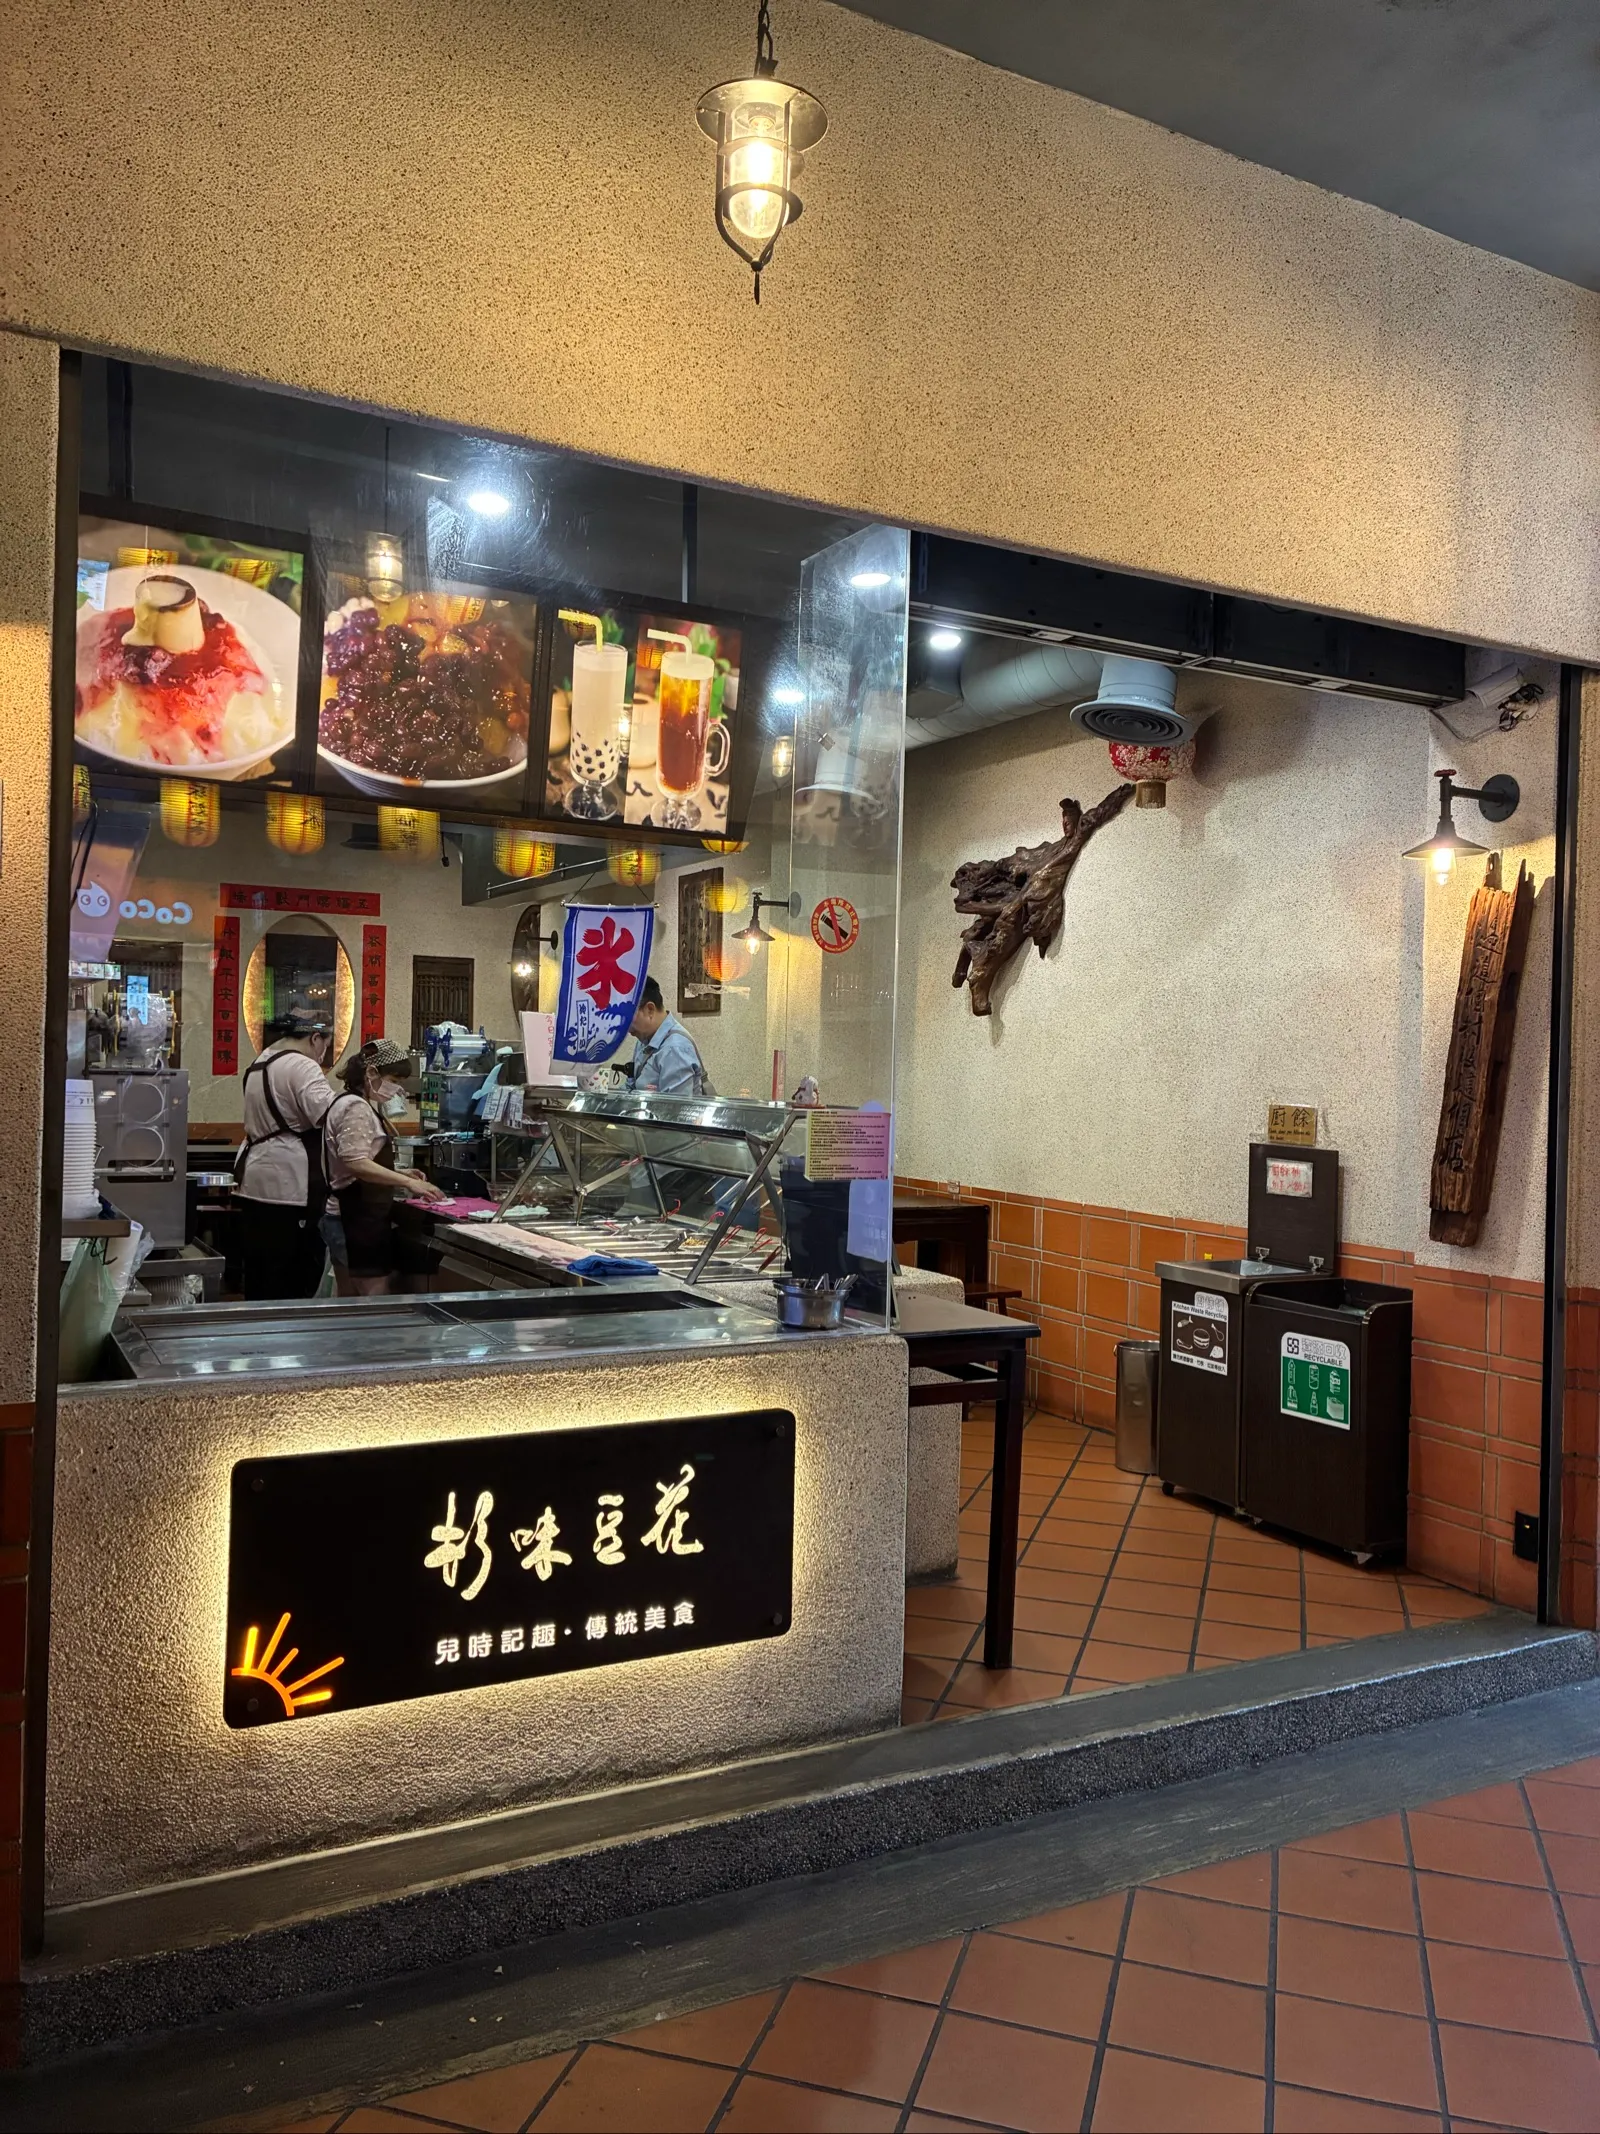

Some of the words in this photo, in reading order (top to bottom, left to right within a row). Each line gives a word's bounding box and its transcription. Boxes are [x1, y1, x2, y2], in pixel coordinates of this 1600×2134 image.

[1271, 1106, 1310, 1128] 廚餘
[1173, 1302, 1190, 1312] Kitchen
[1191, 1306, 1204, 1315] Waste
[1205, 1309, 1227, 1321] Recycling
[1304, 1353, 1343, 1367] RECYCLABLE
